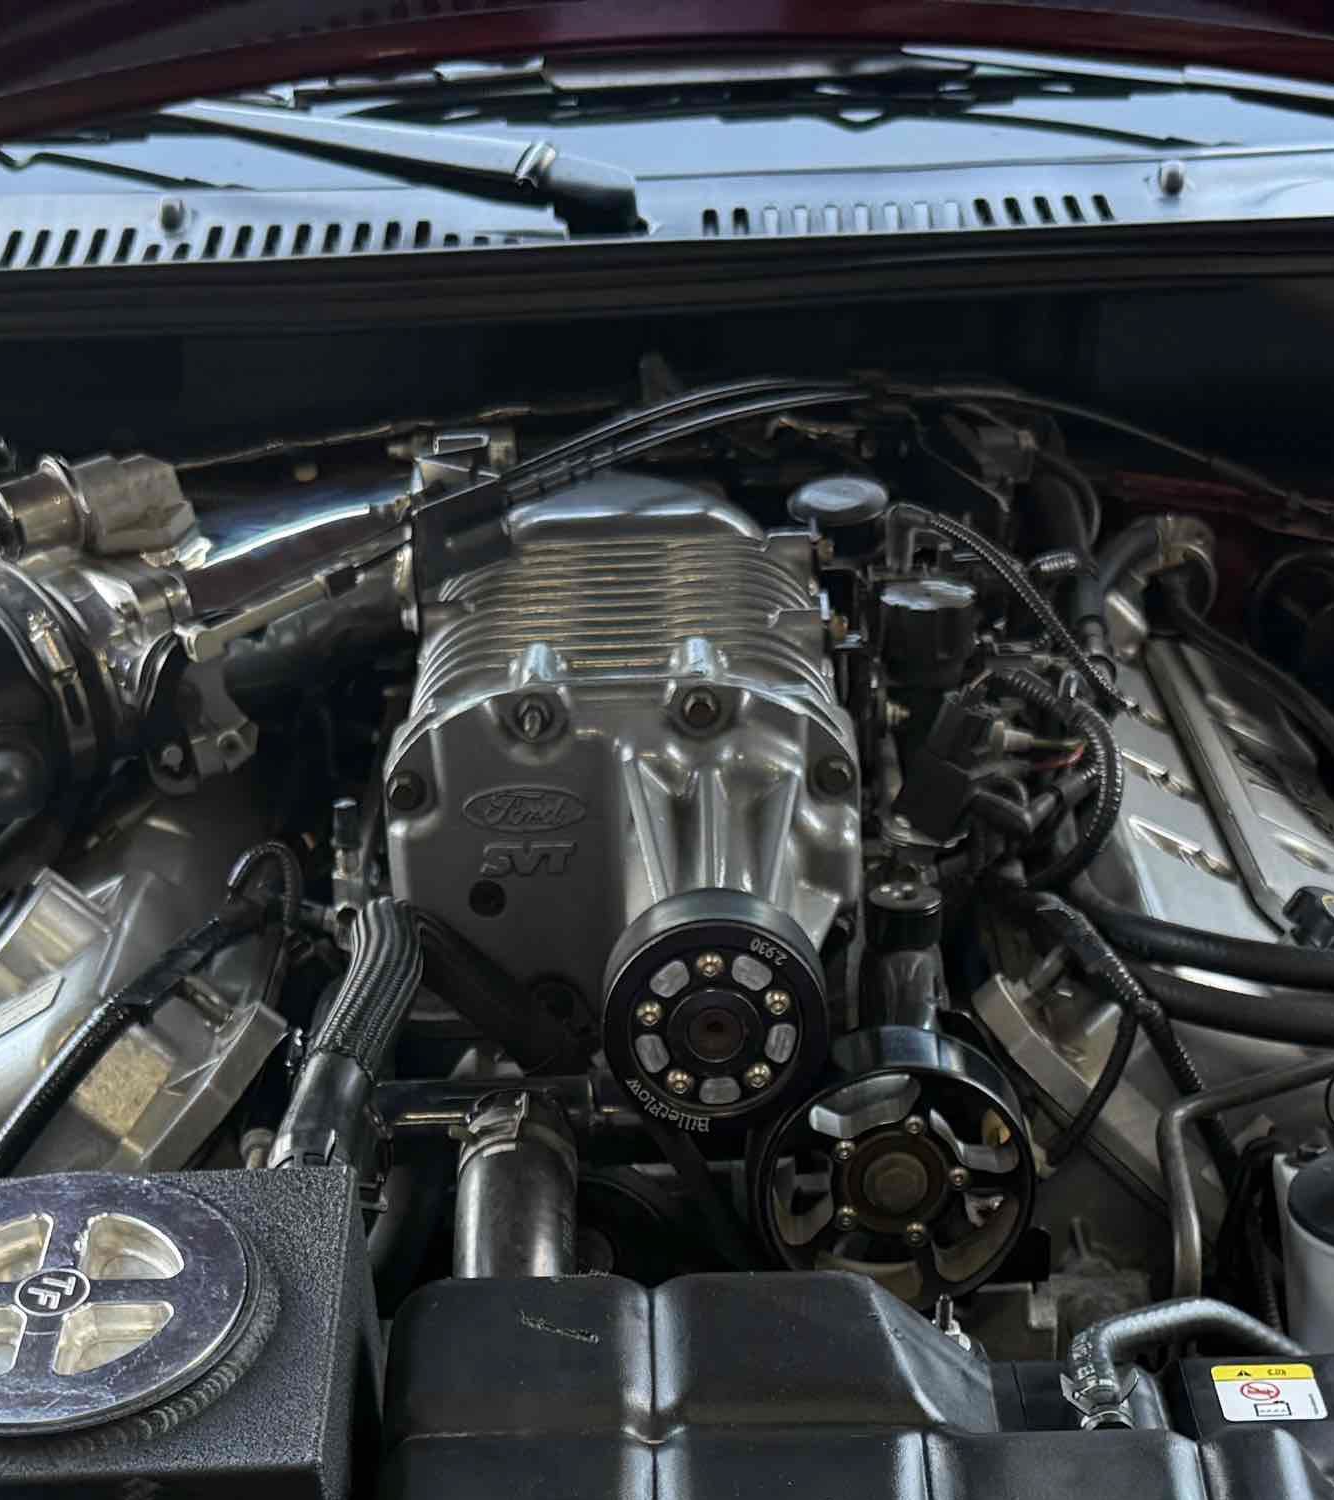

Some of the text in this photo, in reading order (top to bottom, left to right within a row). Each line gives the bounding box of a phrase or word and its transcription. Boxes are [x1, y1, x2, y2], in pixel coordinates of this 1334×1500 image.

[485, 793, 566, 824] Ford
[480, 841, 578, 878] SVT
[750, 936, 788, 966] 2.930
[26, 1276, 77, 1310] TF
